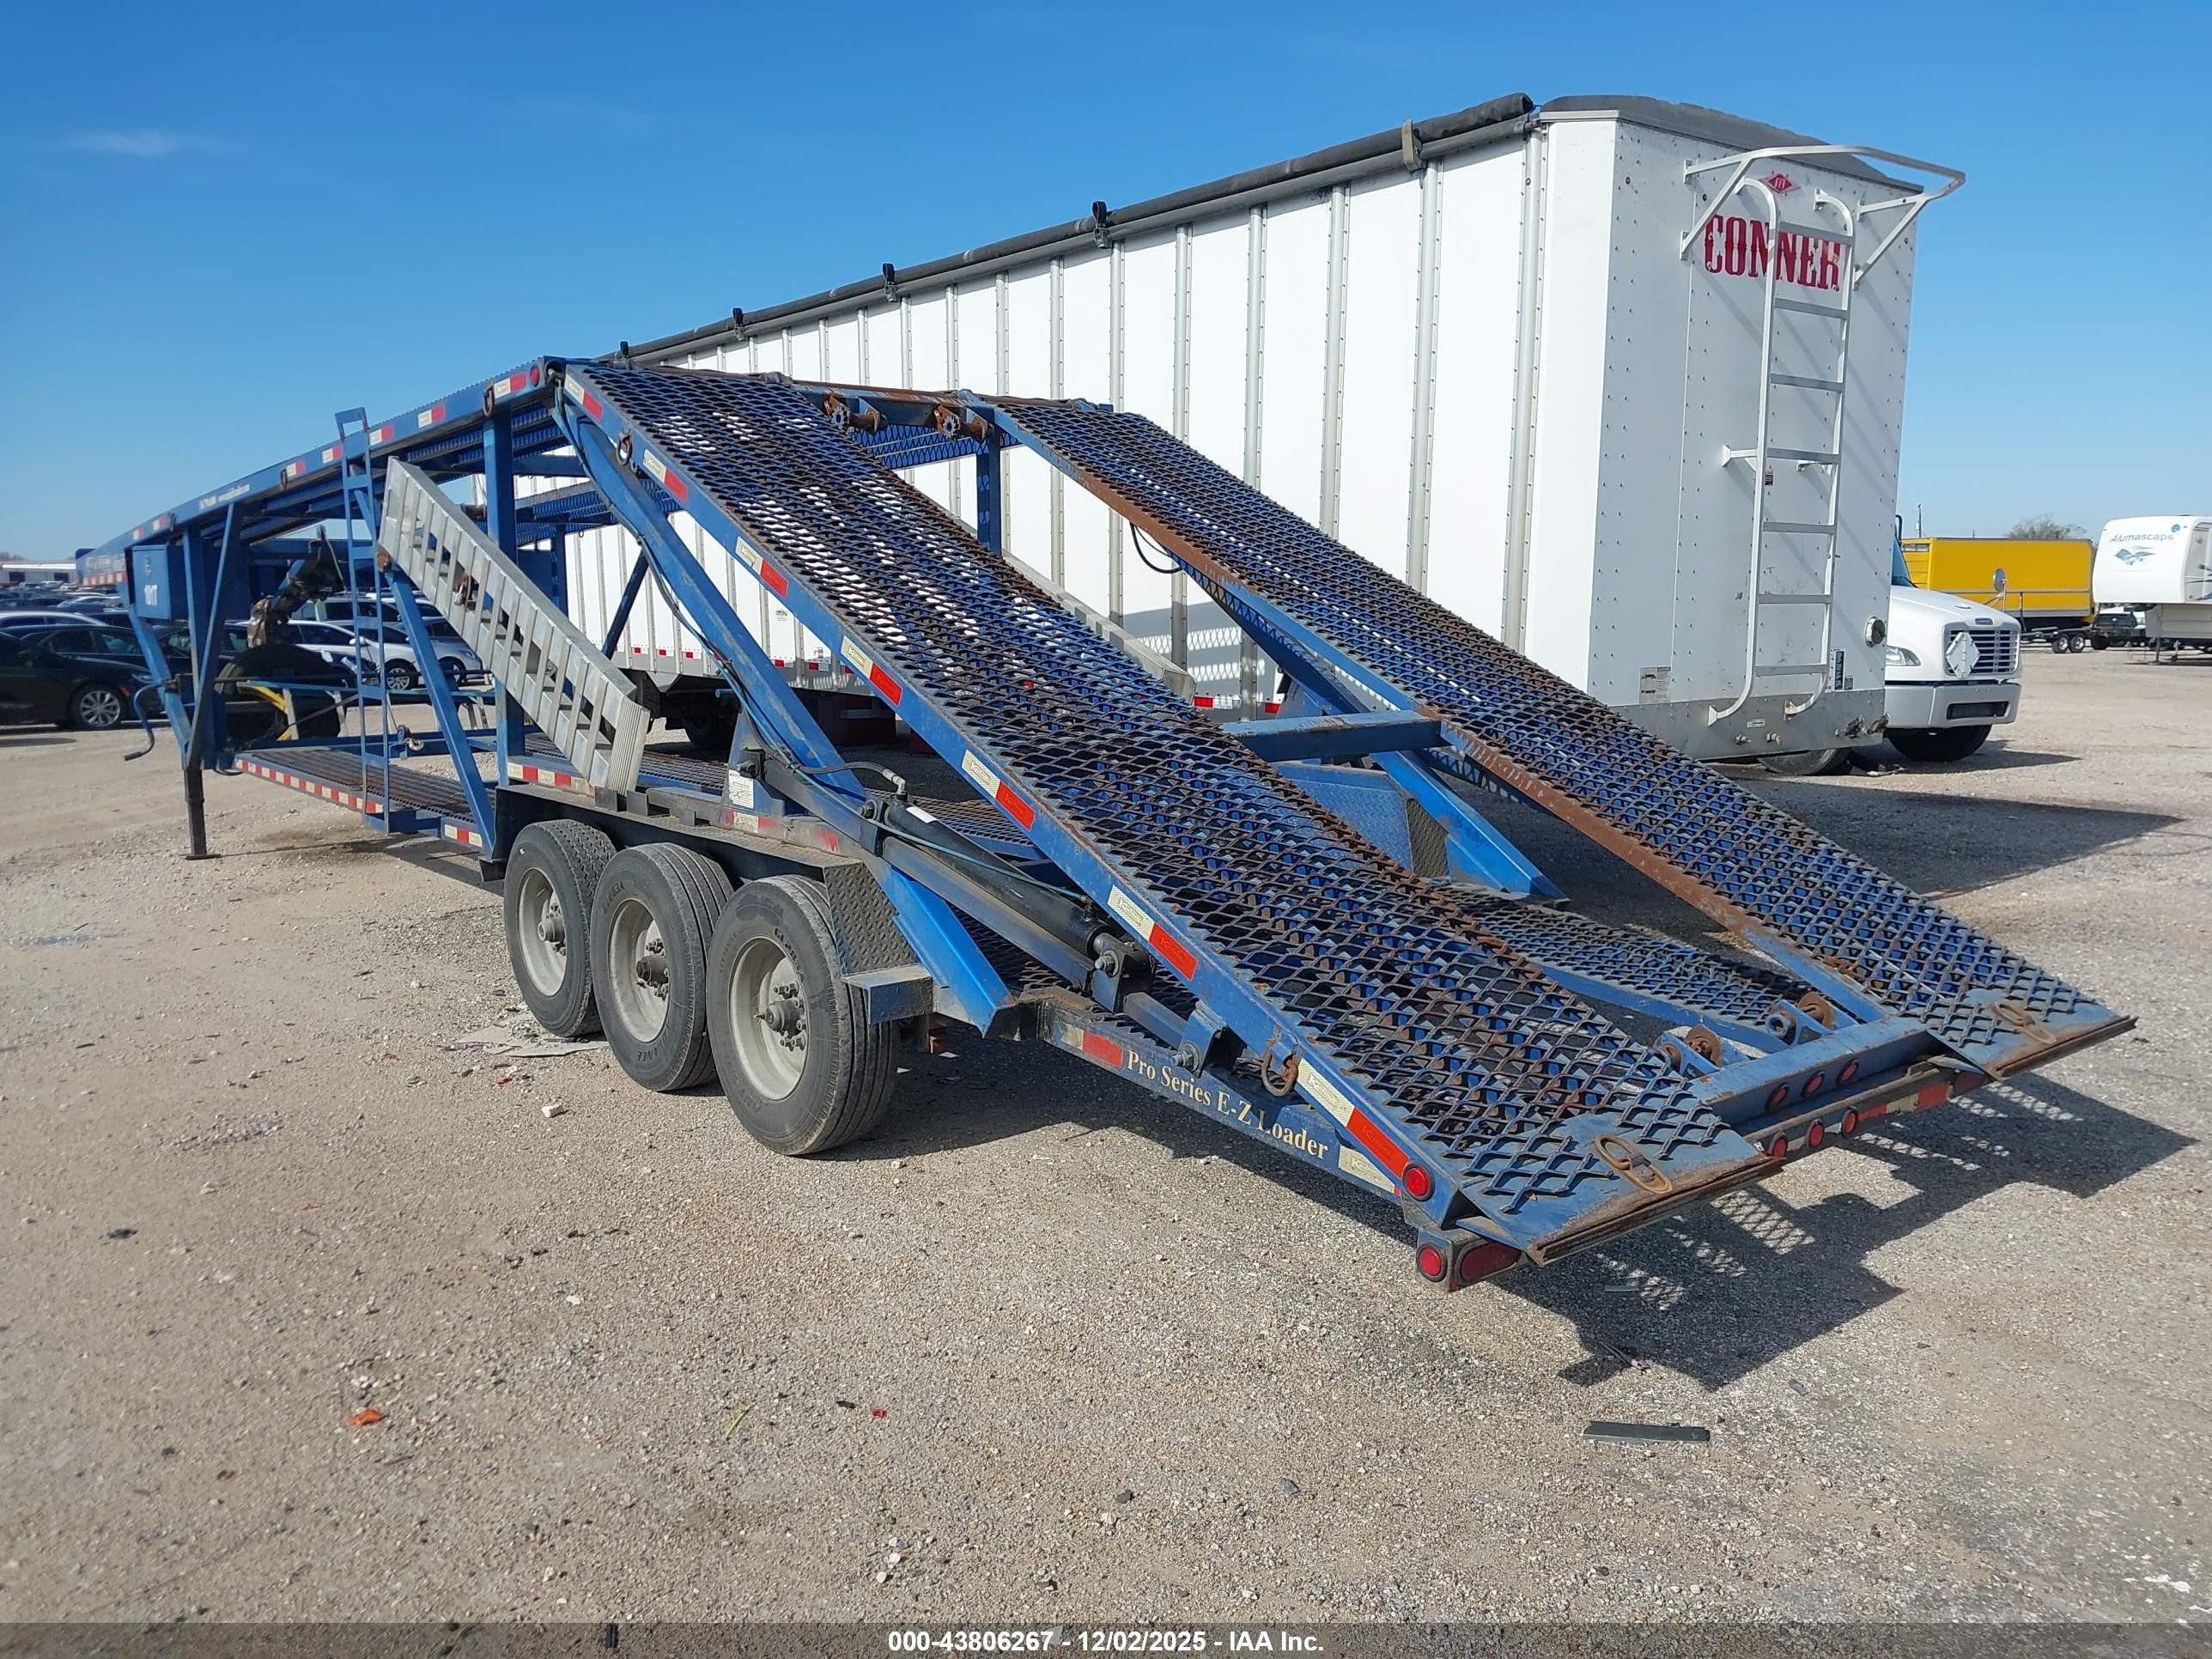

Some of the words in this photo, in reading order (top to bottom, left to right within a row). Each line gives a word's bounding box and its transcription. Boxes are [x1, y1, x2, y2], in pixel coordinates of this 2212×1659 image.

[1705, 214, 1841, 292] CONNER
[2109, 533, 2174, 544] Alumascape
[1127, 1049, 1156, 1080] Pro
[1161, 1066, 1212, 1106] Series
[1217, 1090, 1252, 1126] E-Z
[1256, 1109, 1328, 1160] Loader
